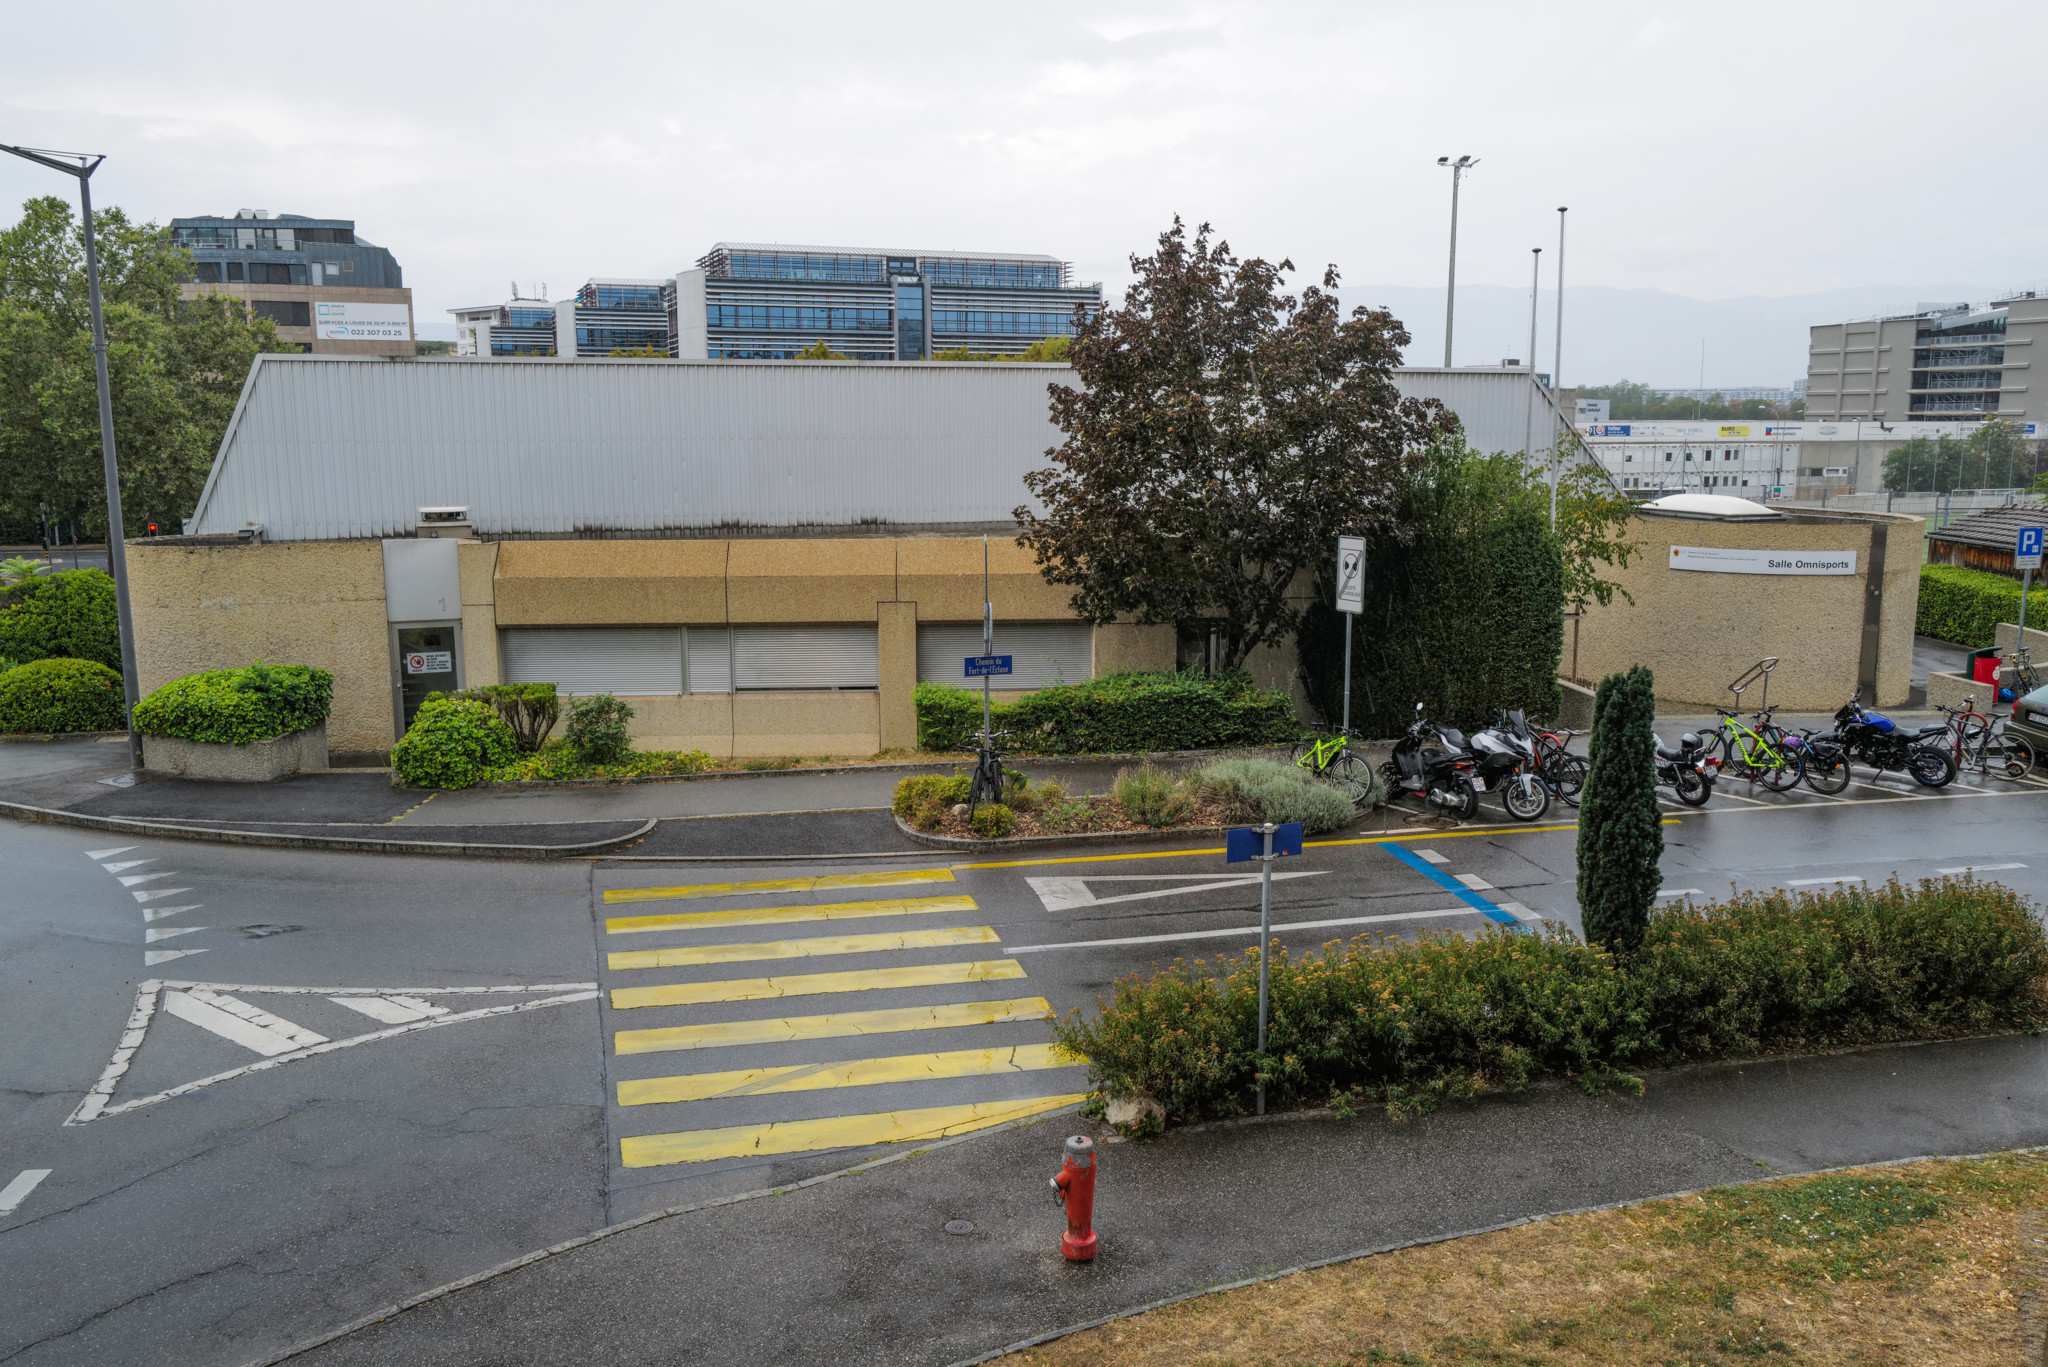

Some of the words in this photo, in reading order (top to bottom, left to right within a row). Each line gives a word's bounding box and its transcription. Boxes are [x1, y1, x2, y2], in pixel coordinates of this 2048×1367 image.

[2022, 531, 2036, 552] P
[1767, 560, 1793, 569] Salle
[1795, 560, 1849, 570] Omnisports
[975, 657, 994, 666] Chemin
[995, 657, 1002, 665] du
